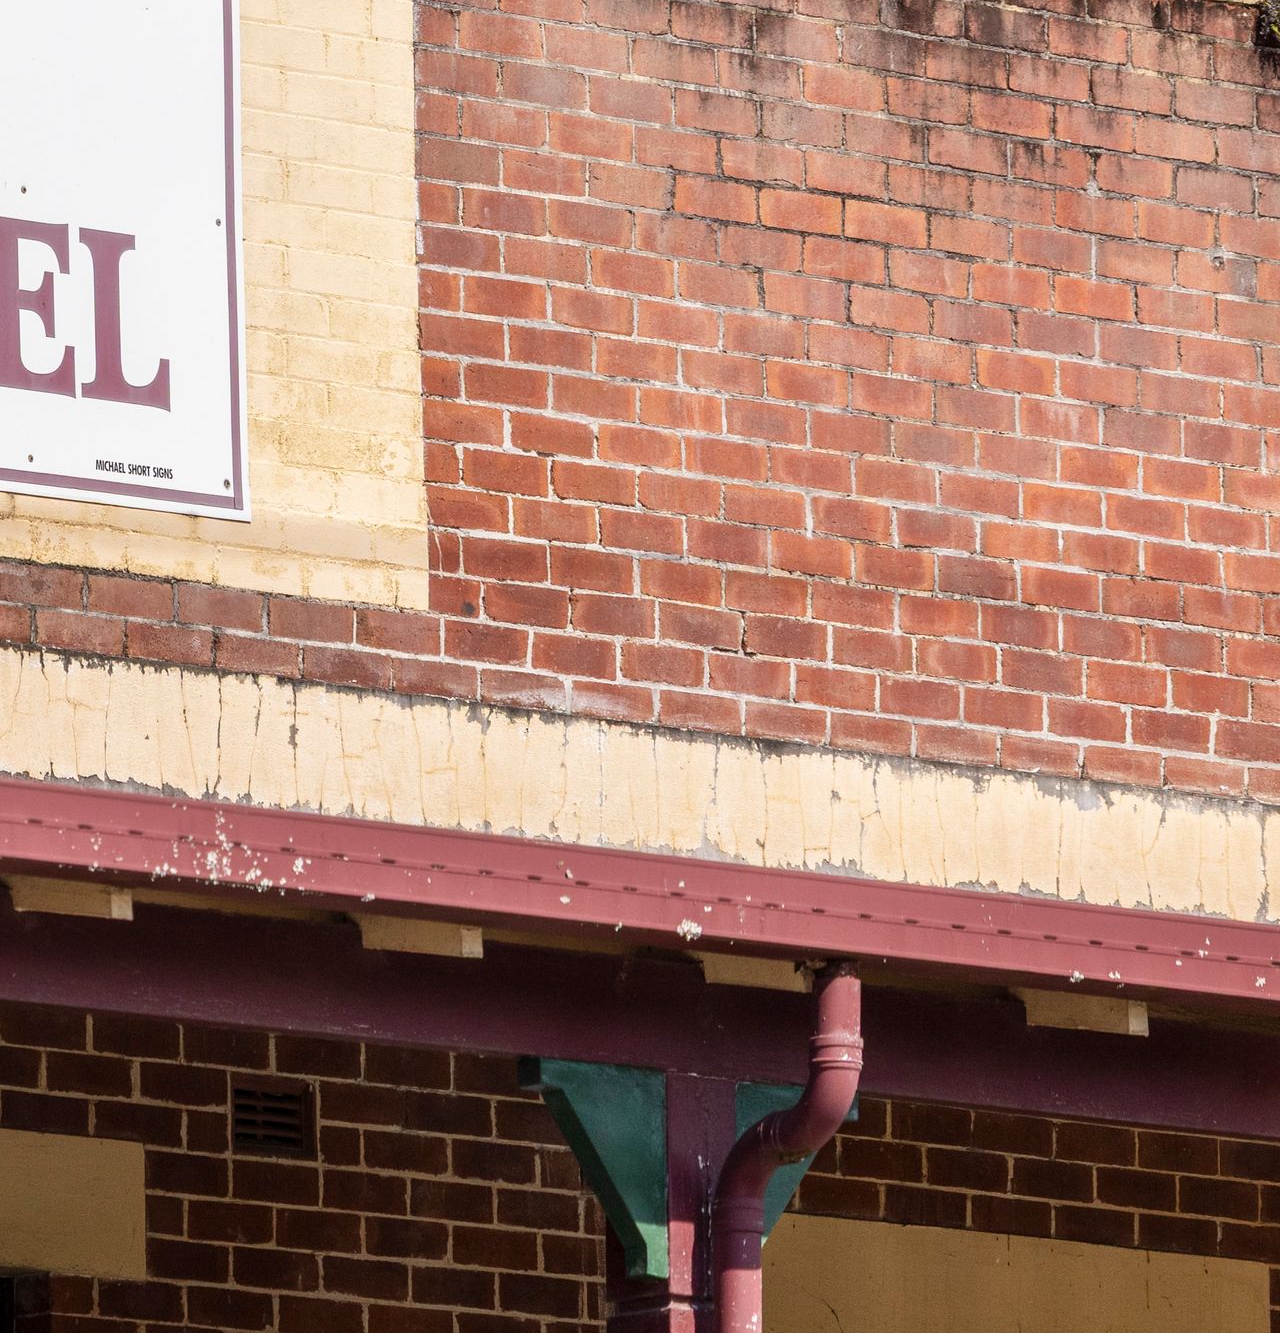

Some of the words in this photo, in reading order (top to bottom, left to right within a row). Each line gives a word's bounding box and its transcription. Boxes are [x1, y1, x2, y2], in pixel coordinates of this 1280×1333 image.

[95, 459, 126, 474] MICHAEL
[128, 463, 151, 477] SHORT
[153, 467, 174, 480] SIGNS
